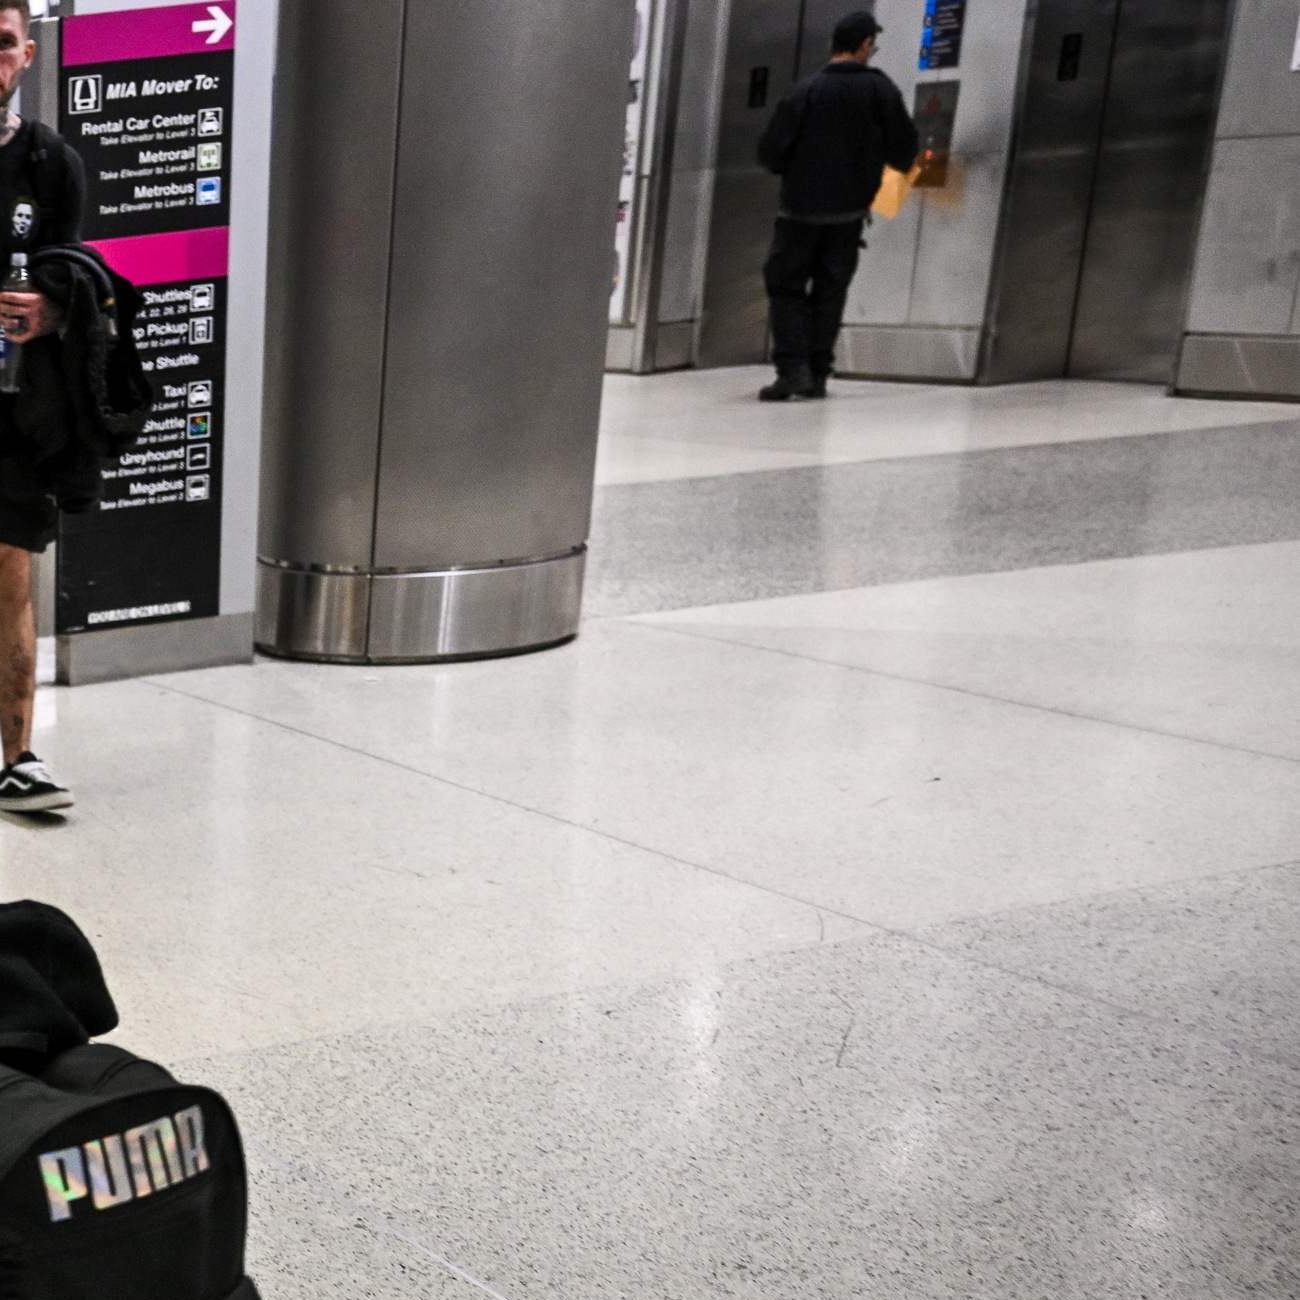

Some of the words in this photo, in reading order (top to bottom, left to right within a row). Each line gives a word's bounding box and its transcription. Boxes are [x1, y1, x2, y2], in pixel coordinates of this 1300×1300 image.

[106, 81, 137, 100] MIA
[141, 79, 192, 96] Mover
[194, 74, 220, 90] To:
[82, 119, 123, 136] Rental
[126, 117, 150, 131] Car
[152, 113, 196, 128] Center
[101, 136, 119, 146] Take
[139, 146, 196, 164] Metrorail
[100, 170, 119, 180] Take
[134, 181, 195, 199] Metrobus
[99, 204, 118, 215] Take
[142, 288, 192, 305] Shuttles
[147, 322, 189, 337] Pickup
[156, 353, 199, 370] Shuttle
[163, 384, 186, 398] Taxi
[120, 446, 185, 466] Greyhound
[129, 479, 185, 496] Megabus
[38, 1104, 210, 1223] PUMA
